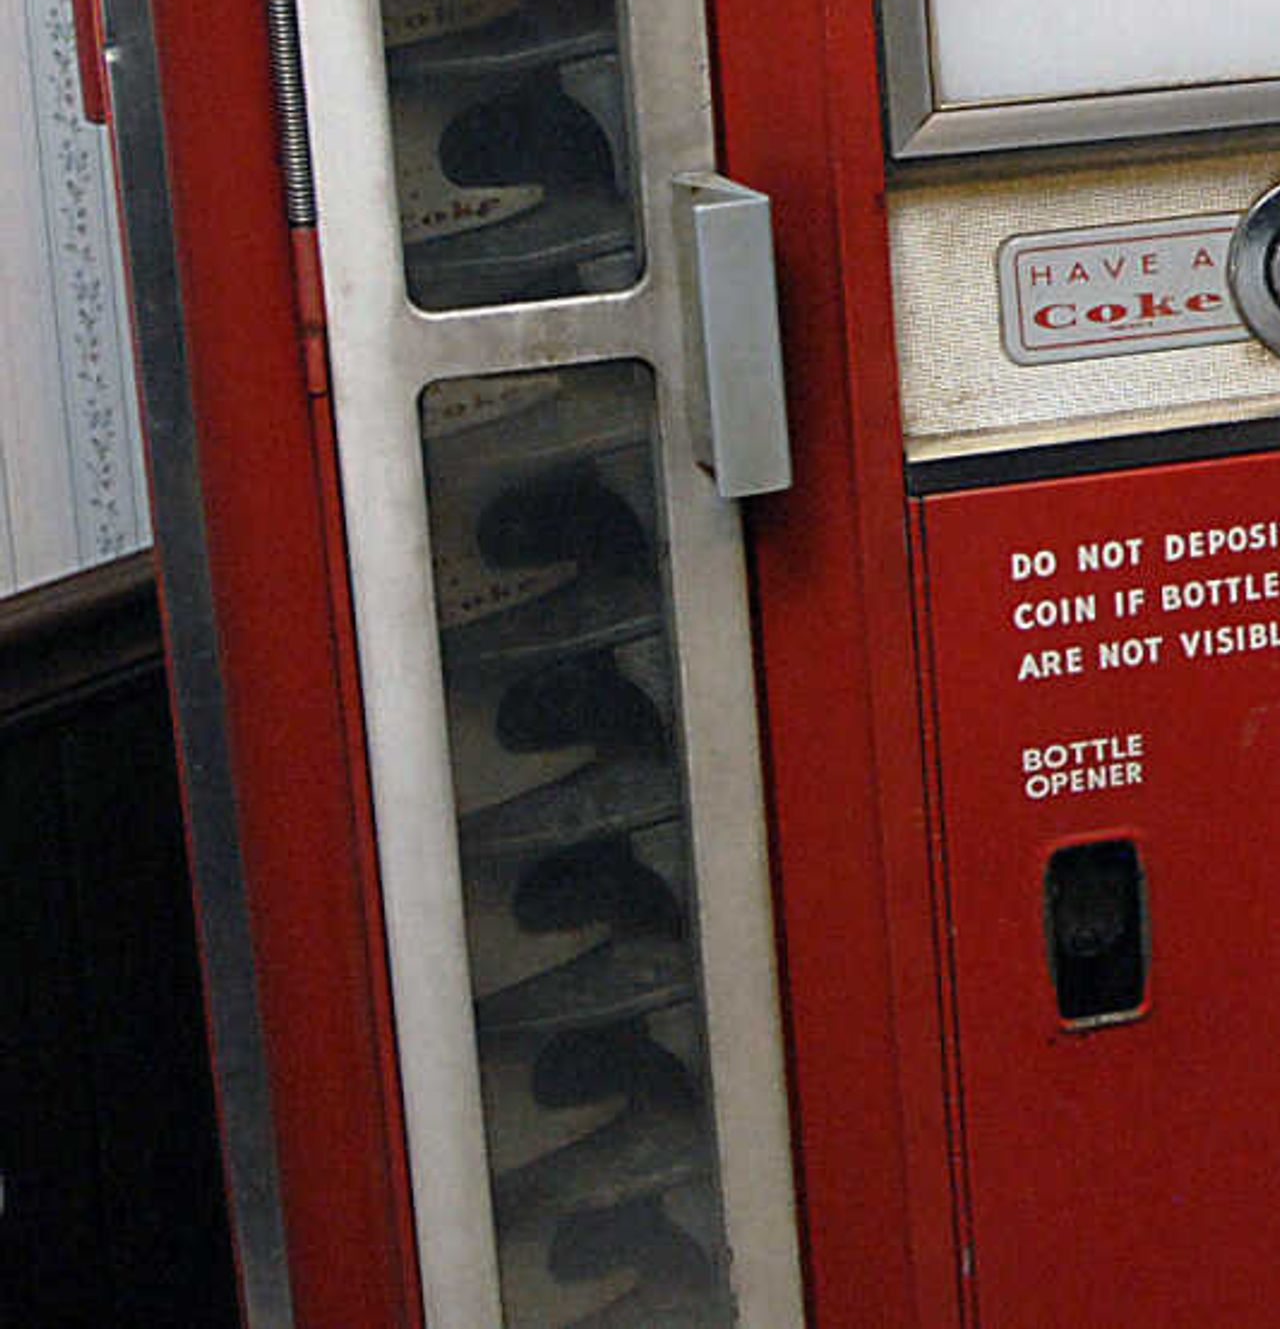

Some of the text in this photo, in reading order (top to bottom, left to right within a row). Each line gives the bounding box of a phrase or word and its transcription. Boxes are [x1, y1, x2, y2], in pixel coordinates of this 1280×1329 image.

[1030, 246, 1215, 286] HAVE A
[1034, 292, 1224, 330] Coke
[1010, 550, 1057, 581] DO
[1077, 538, 1144, 572] NOT
[1013, 594, 1096, 630] COIN
[1115, 589, 1145, 618] IF
[1017, 647, 1083, 681] ARE
[1099, 636, 1163, 670] NOT
[1022, 733, 1144, 773] BOTTLE
[1024, 761, 1144, 800] OPENER
